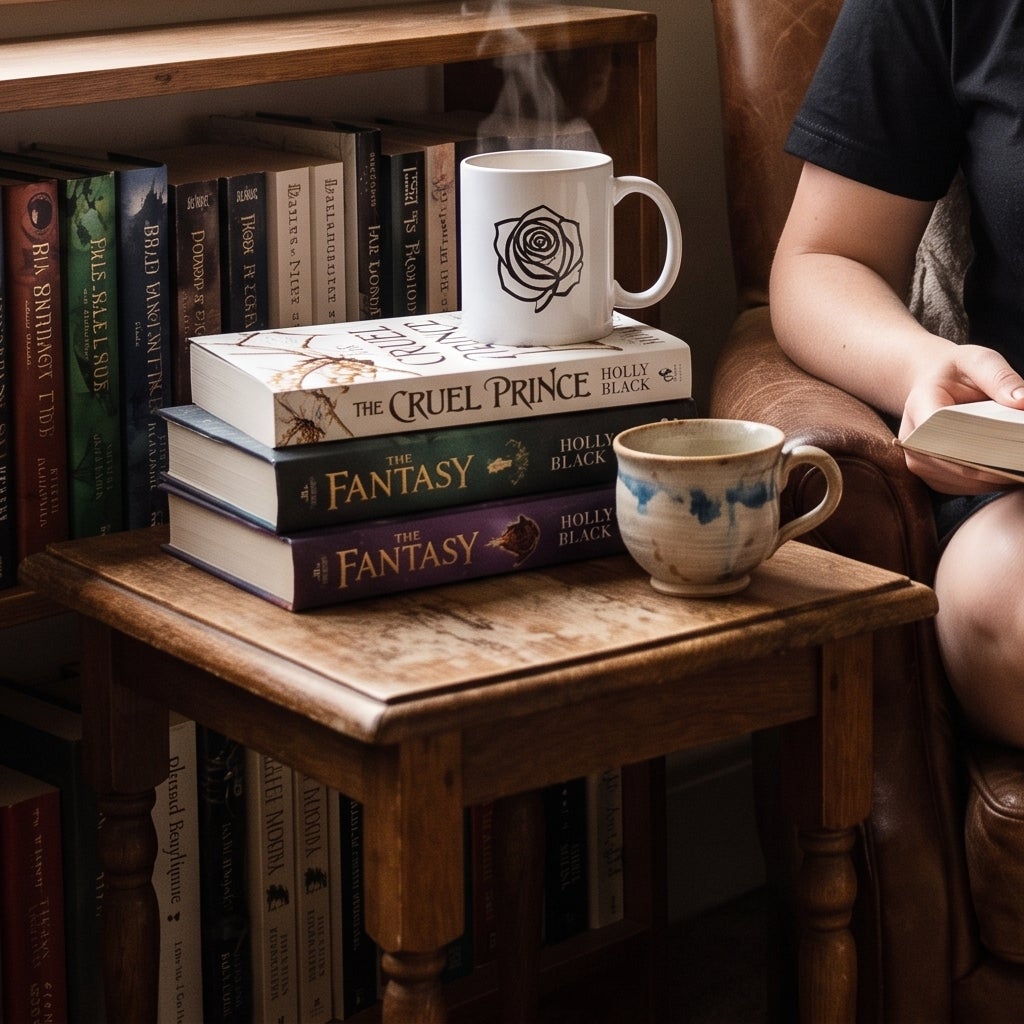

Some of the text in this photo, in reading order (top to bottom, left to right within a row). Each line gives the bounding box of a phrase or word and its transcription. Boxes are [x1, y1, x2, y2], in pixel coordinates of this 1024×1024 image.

[601, 362, 649, 380] HOLLY
[353, 366, 592, 422] THE CRUEL PRINCE
[602, 378, 650, 396] BLACK
[560, 433, 614, 453] HOLLY
[386, 453, 412, 465] THE
[551, 450, 607, 471] BLACK
[325, 454, 475, 510] FANTASY
[560, 507, 613, 528] HOLLY
[394, 530, 420, 542] THE
[558, 524, 612, 546] BLACK
[336, 532, 480, 588] FANTASY
